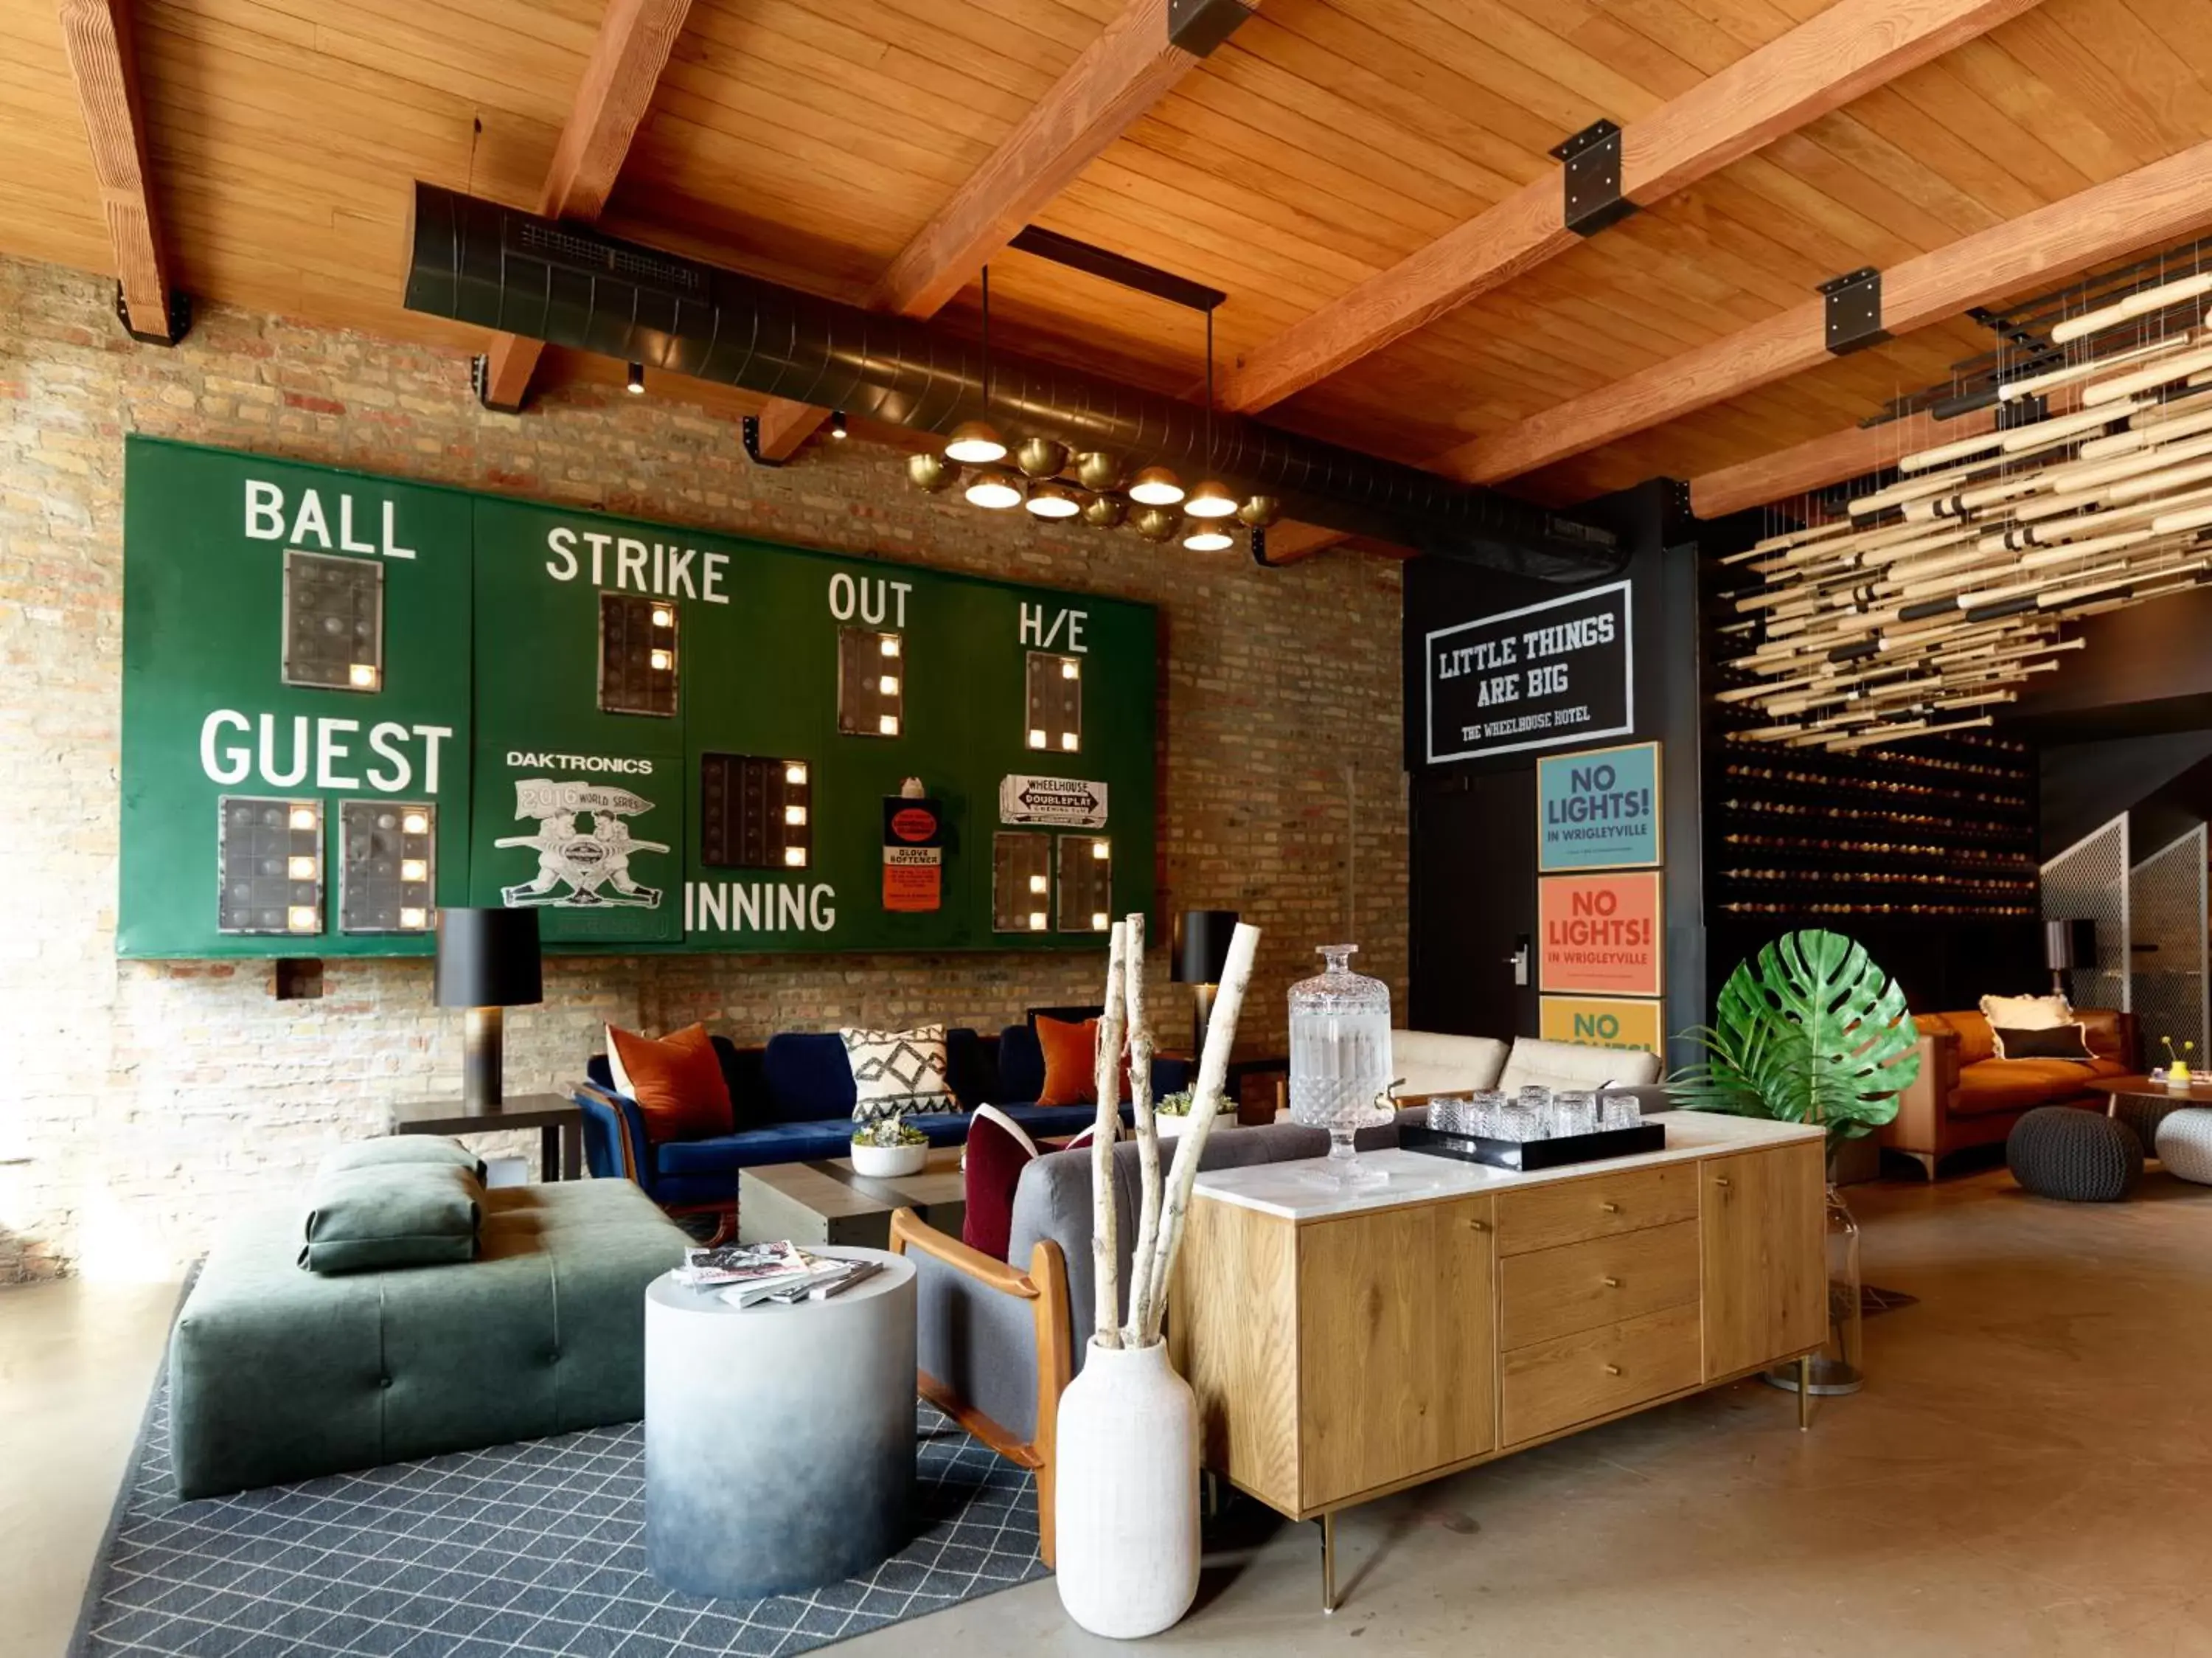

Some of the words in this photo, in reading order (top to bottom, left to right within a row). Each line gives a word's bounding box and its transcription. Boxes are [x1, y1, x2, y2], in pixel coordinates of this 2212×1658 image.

[245, 479, 417, 559] BALL
[546, 527, 730, 604] STRIKE
[828, 572, 913, 628] OUT
[1020, 602, 1088, 653] H/E
[1439, 637, 1517, 679] LITTLE
[1523, 612, 1615, 660] THINGS
[1477, 673, 1520, 707] ARE
[1526, 663, 1568, 698] BIG
[1461, 725, 1481, 742] THE
[1483, 712, 1552, 737] WHEELHOUSE
[1554, 706, 1590, 726] HOTEL
[200, 709, 453, 794] GUEST
[506, 752, 653, 774] DAKTRONICS
[521, 785, 577, 809] 2016
[579, 793, 609, 807] WORLD
[613, 796, 639, 809] SERIES
[1028, 780, 1088, 793] WHEELHOUSE
[1571, 764, 1616, 794] NO
[1548, 788, 1650, 824] LIGHTS!
[1548, 830, 1559, 842] IN
[1562, 824, 1648, 841] WRIGLEYVILLE
[684, 881, 836, 932] INNING
[1572, 889, 1618, 917] NO
[1549, 918, 1651, 946] LIGHTS!
[1548, 952, 1560, 963] IN
[1563, 952, 1648, 965] WRIGLEYVILLE
[1573, 1013, 1620, 1039] NO
